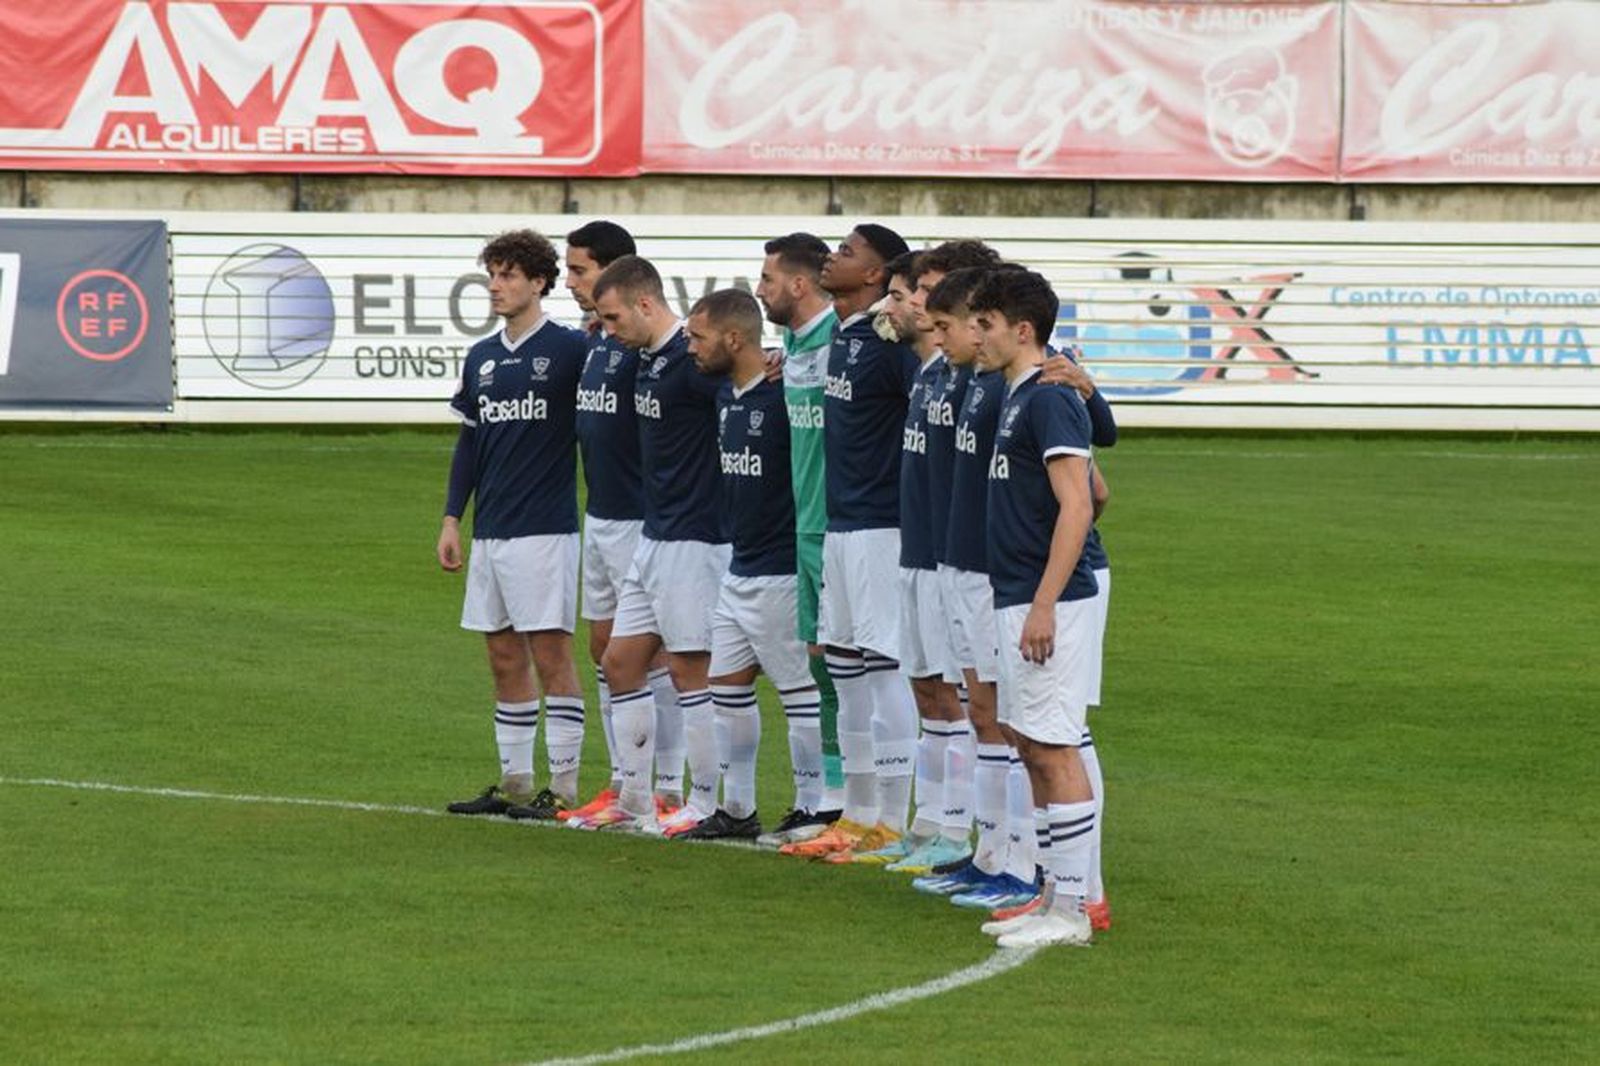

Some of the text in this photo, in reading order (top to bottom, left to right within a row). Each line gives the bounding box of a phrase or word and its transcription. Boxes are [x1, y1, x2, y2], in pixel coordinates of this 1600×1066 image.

[62, 2, 543, 155] AMAQ
[679, 12, 1161, 169] Cardiza
[107, 124, 366, 153] ALQUILERES
[352, 273, 499, 337] ELO
[1330, 286, 1426, 307] Centro
[1436, 286, 1471, 307] de
[354, 345, 473, 378] CONST
[1384, 321, 1593, 370] EMMA
[477, 390, 548, 424] Posada
